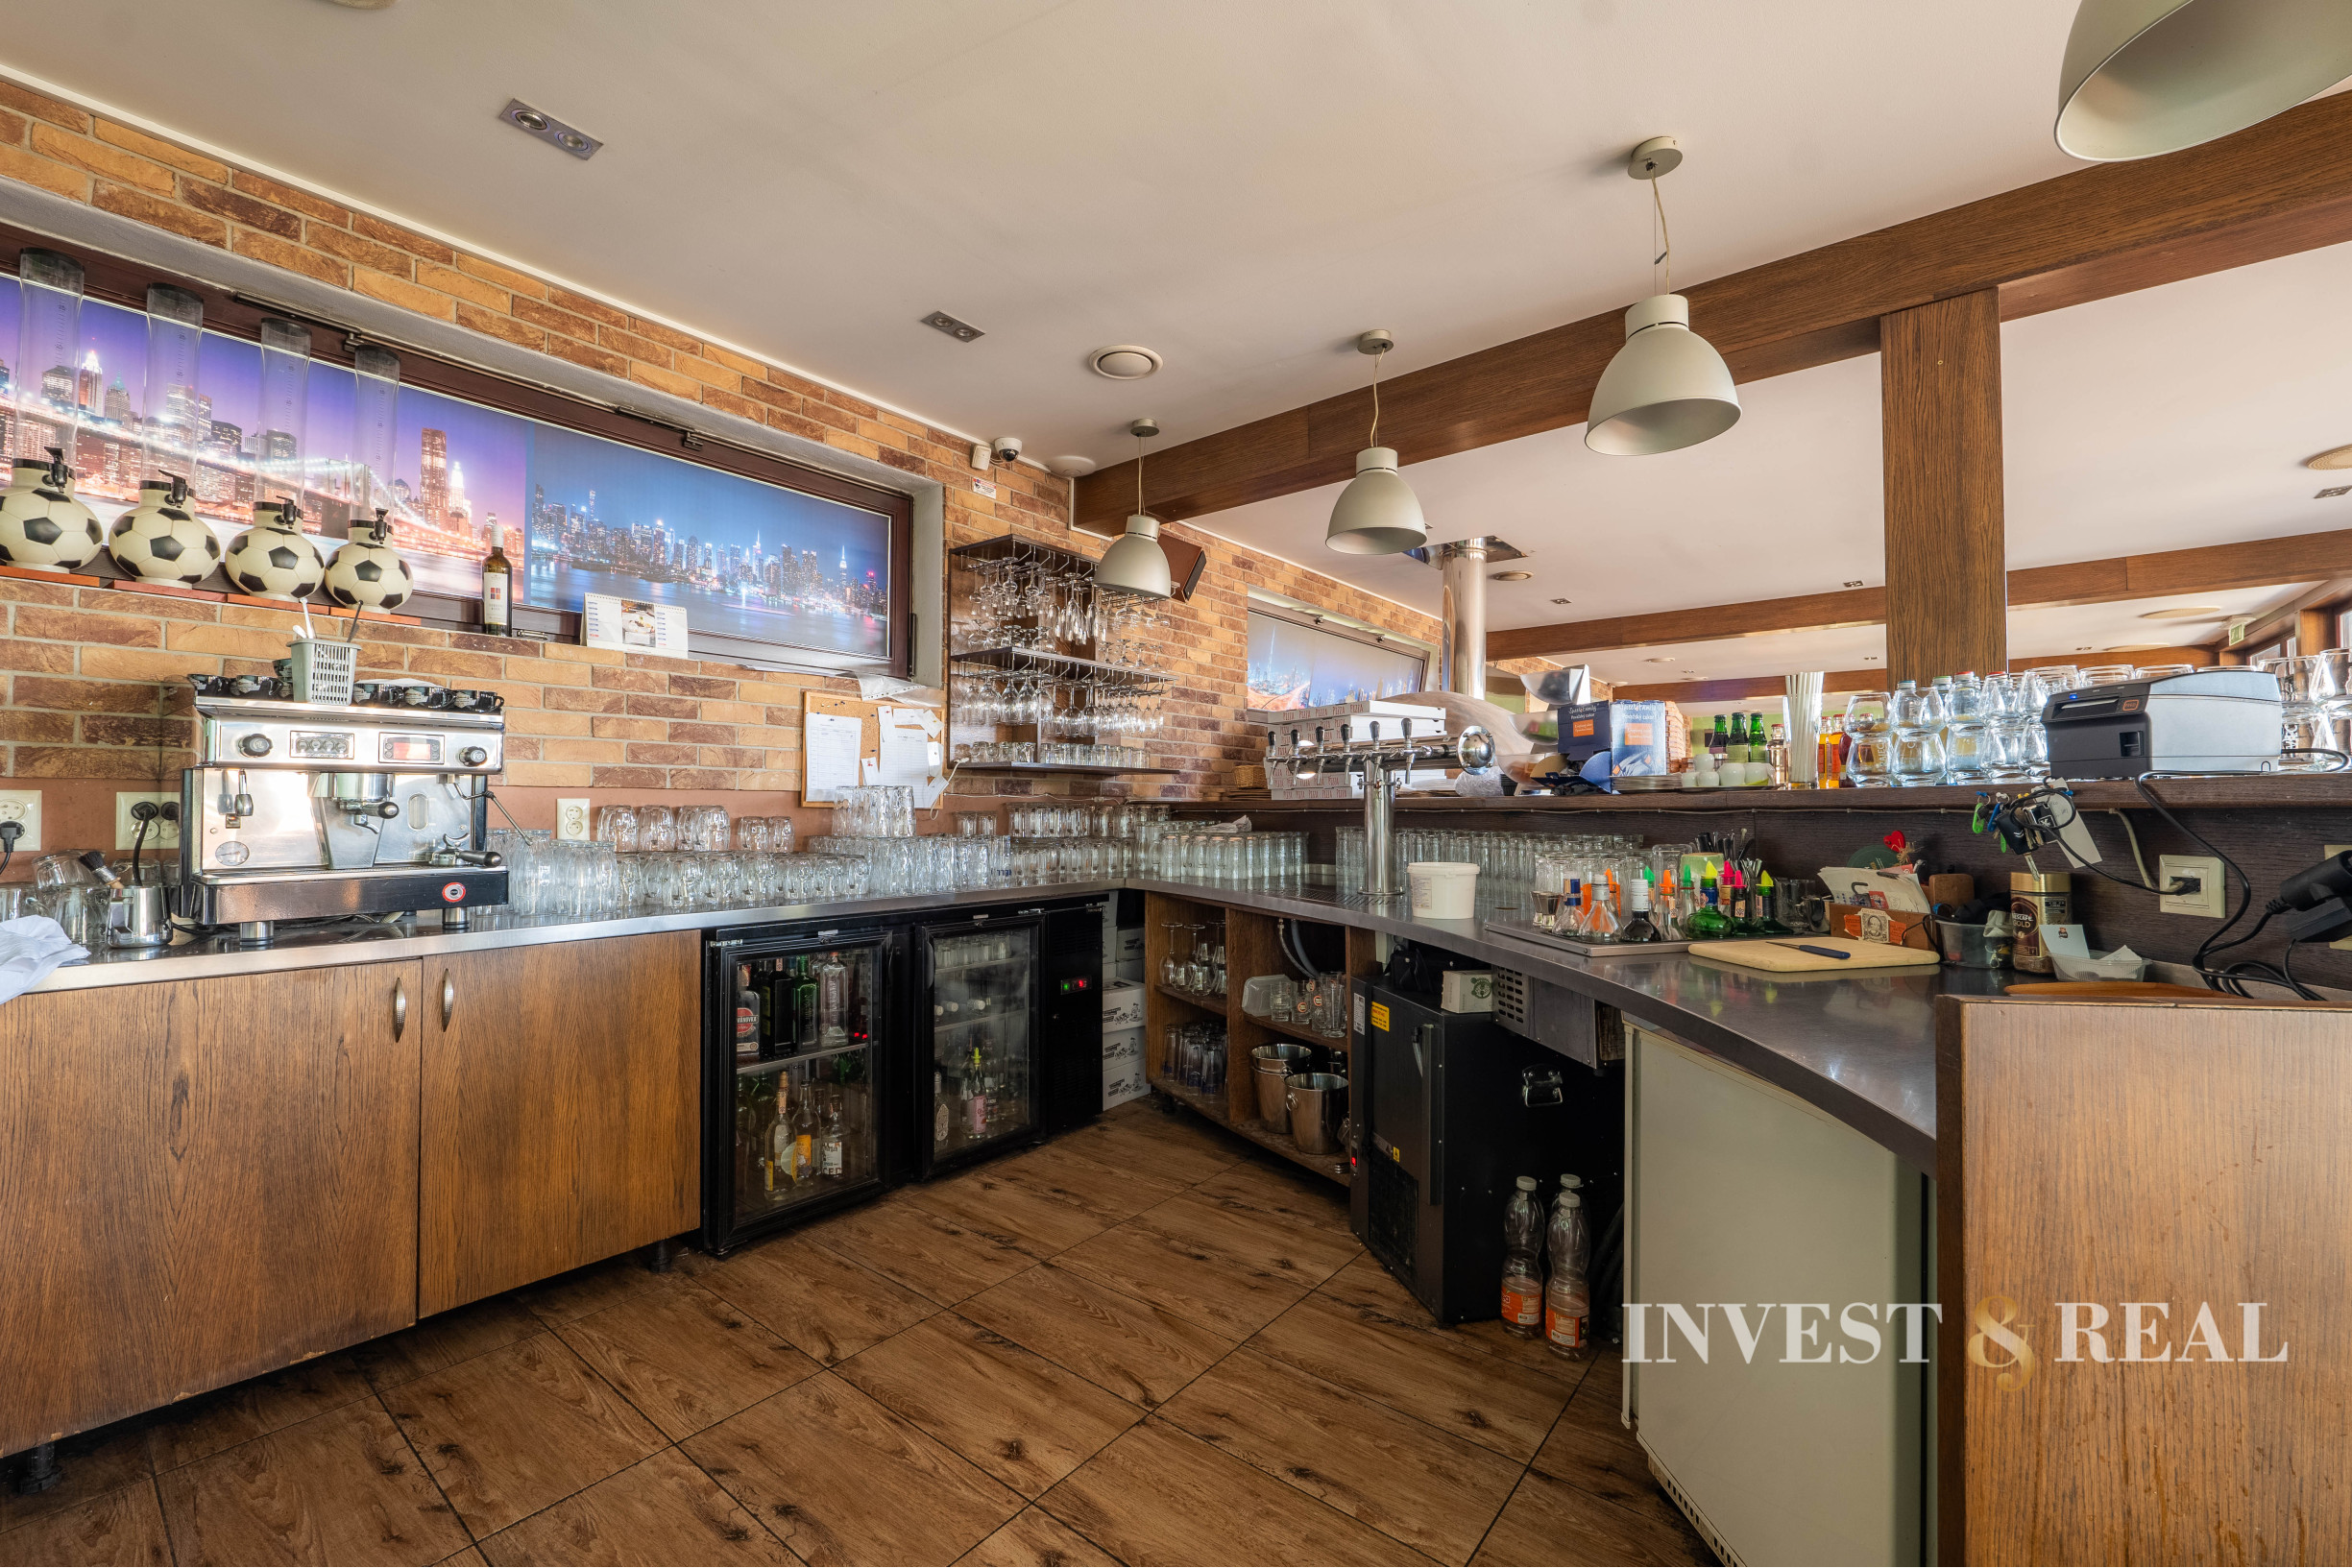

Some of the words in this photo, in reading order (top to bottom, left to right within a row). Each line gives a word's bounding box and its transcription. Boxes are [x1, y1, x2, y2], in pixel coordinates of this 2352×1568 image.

[1299, 710, 1310, 719] PIZZA
[1315, 708, 1327, 717] PIZZA
[1333, 706, 1345, 715] PIZZA
[1350, 704, 1364, 713] PIZZA
